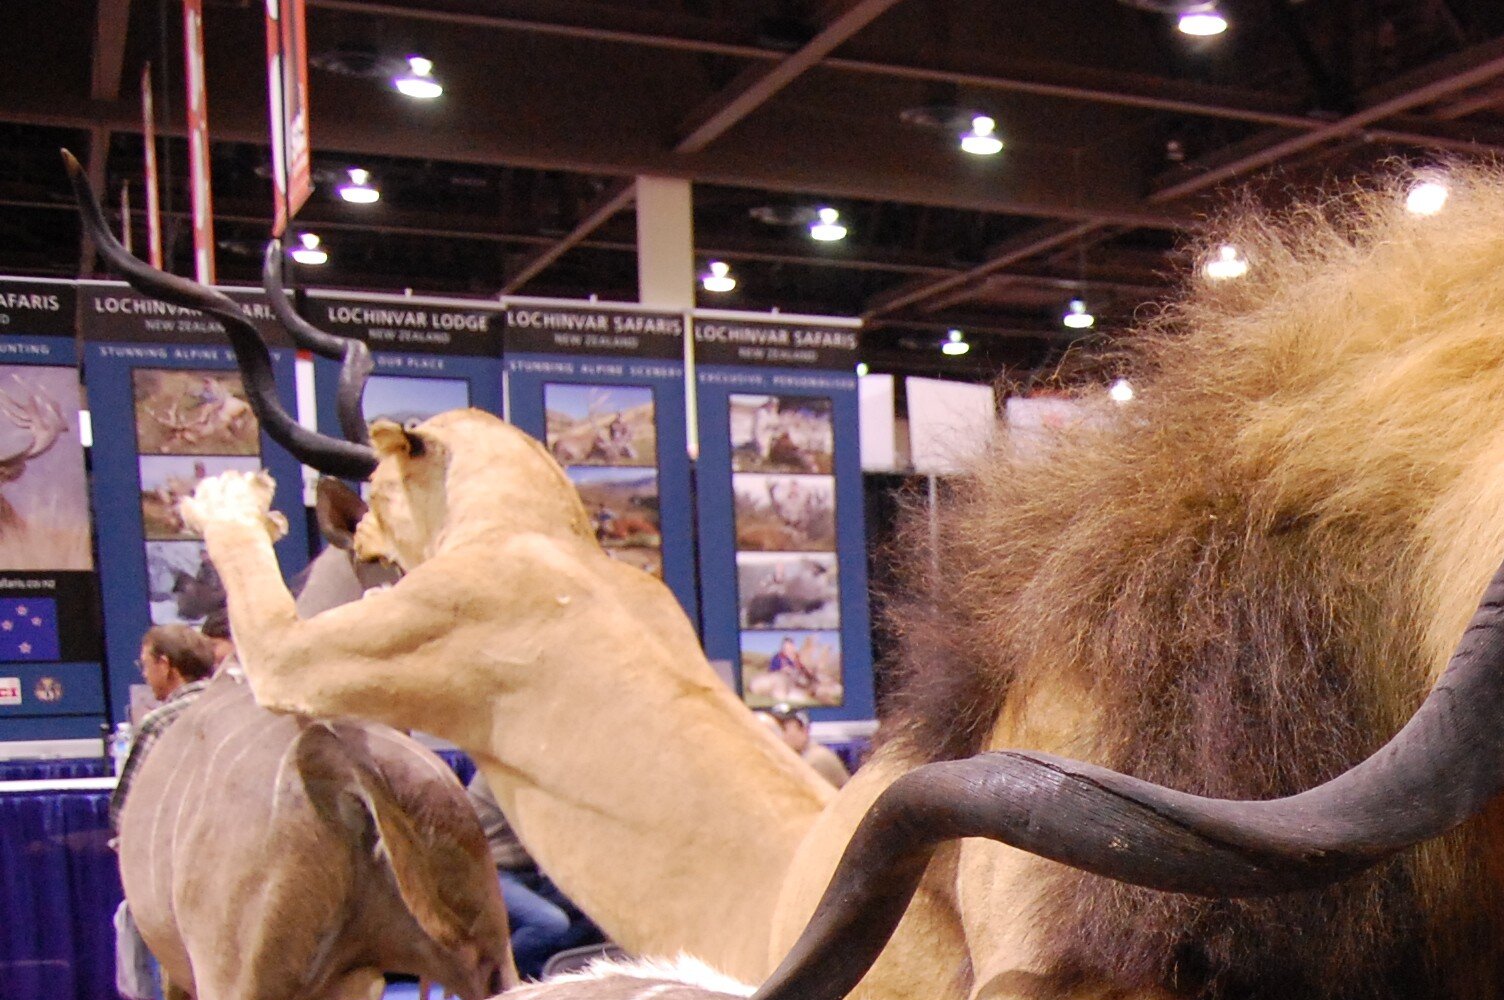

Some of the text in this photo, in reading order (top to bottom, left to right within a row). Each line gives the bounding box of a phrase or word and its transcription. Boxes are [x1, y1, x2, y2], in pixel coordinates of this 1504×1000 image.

[177, 320, 227, 334] ZEALAN
[328, 306, 489, 332] LOCHINVAR LODGE
[507, 310, 683, 337] LOCHINVAR SAFARIS
[695, 325, 858, 350] LOCHINVAR SAFARIS
